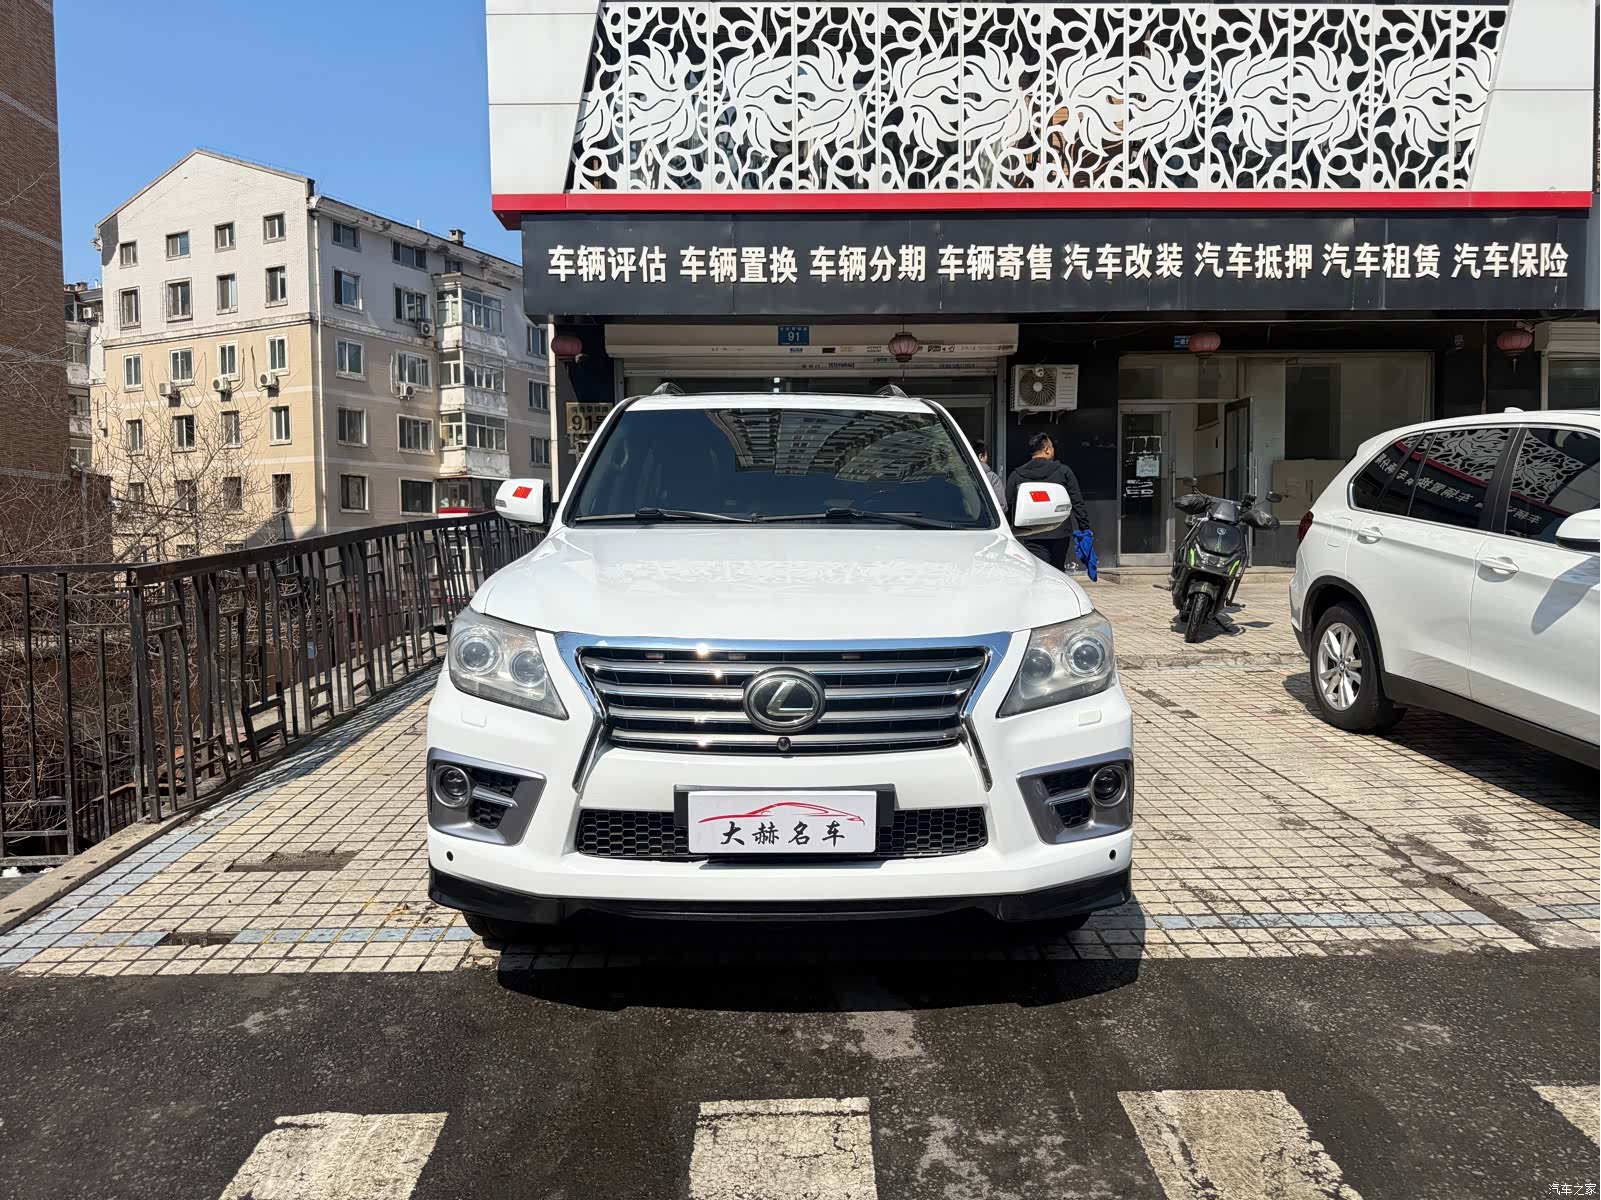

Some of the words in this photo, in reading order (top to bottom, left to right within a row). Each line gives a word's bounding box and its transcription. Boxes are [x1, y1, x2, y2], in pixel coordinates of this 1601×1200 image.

[547, 245, 667, 283] 车辆评估
[679, 245, 798, 284] 车辆置换
[809, 244, 926, 283] 车辆分期
[937, 243, 1053, 282] 车辆寄售
[1062, 242, 1184, 281] 汽车改装
[1194, 241, 1313, 280] 汽车抵押
[1321, 241, 1441, 279] 汽车租赁
[1450, 241, 1569, 279] 汽车保险
[787, 331, 800, 342] 91
[720, 820, 845, 847] 大赫名车
